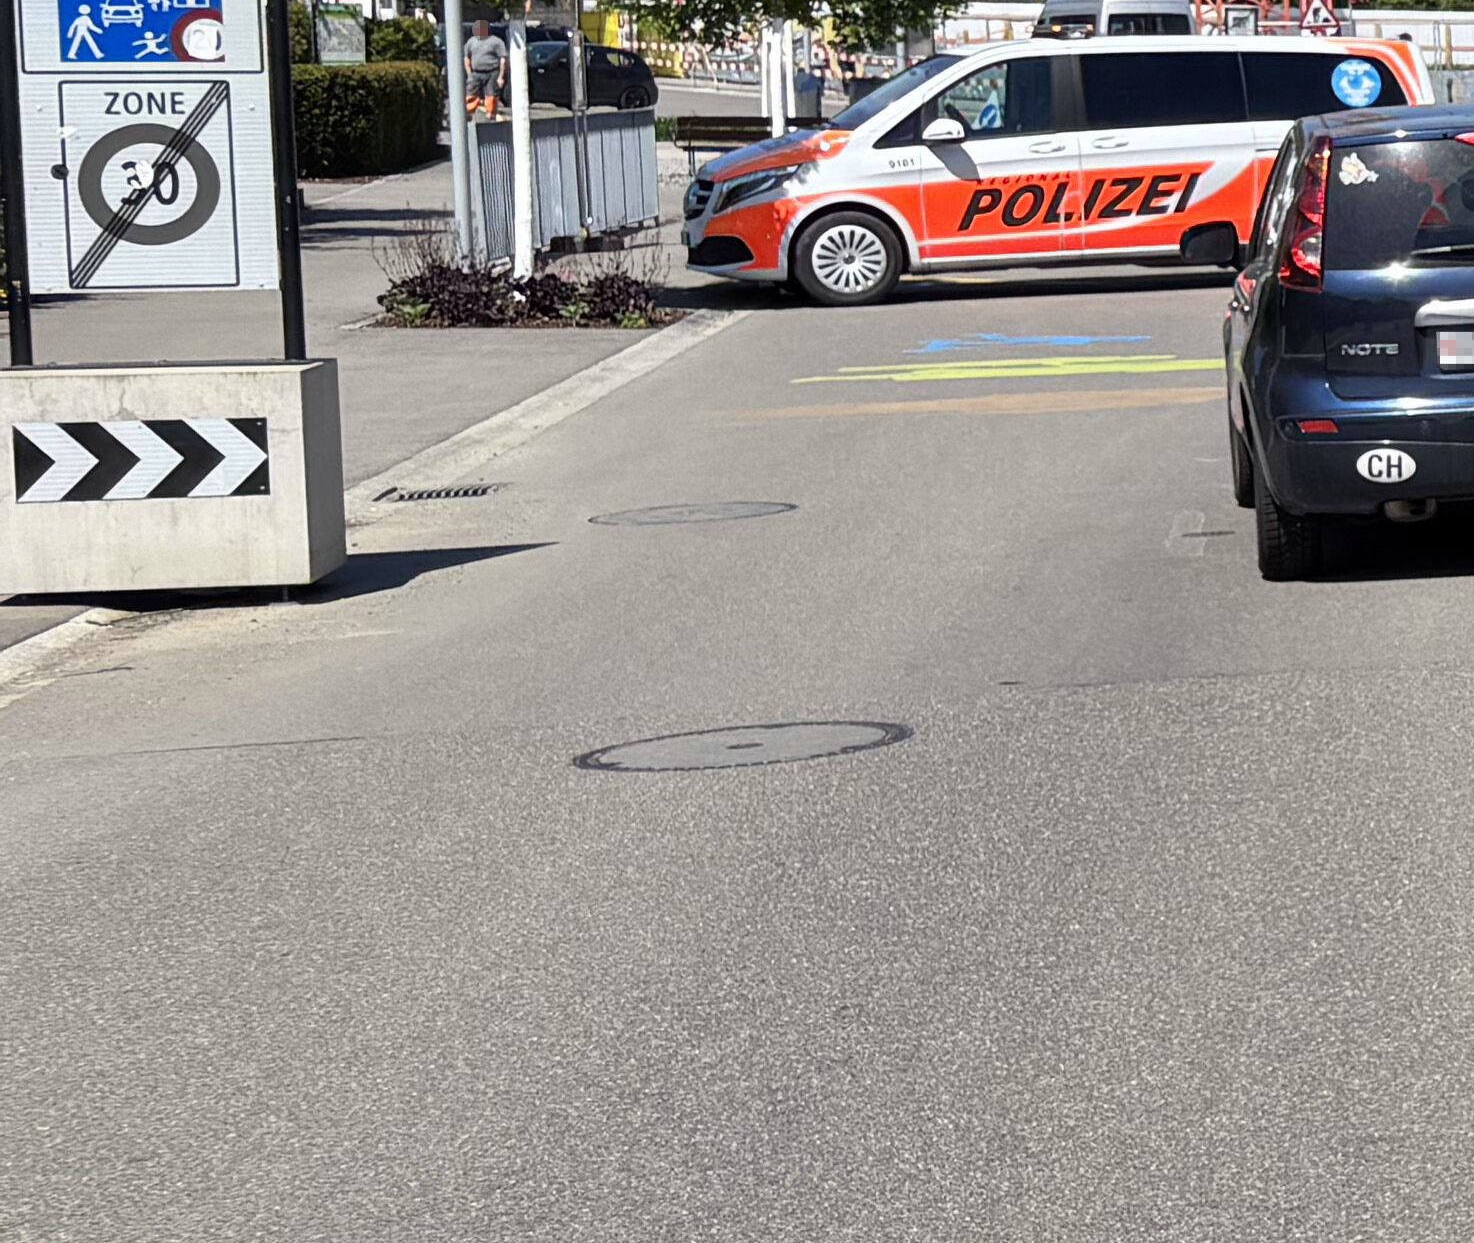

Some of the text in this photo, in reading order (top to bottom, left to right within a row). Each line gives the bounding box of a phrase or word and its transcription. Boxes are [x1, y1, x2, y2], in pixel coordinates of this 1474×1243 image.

[104, 91, 186, 115] ZONE
[957, 172, 1202, 232] POLIZEI
[1341, 343, 1399, 356] NOTE
[1367, 454, 1402, 478] CH
